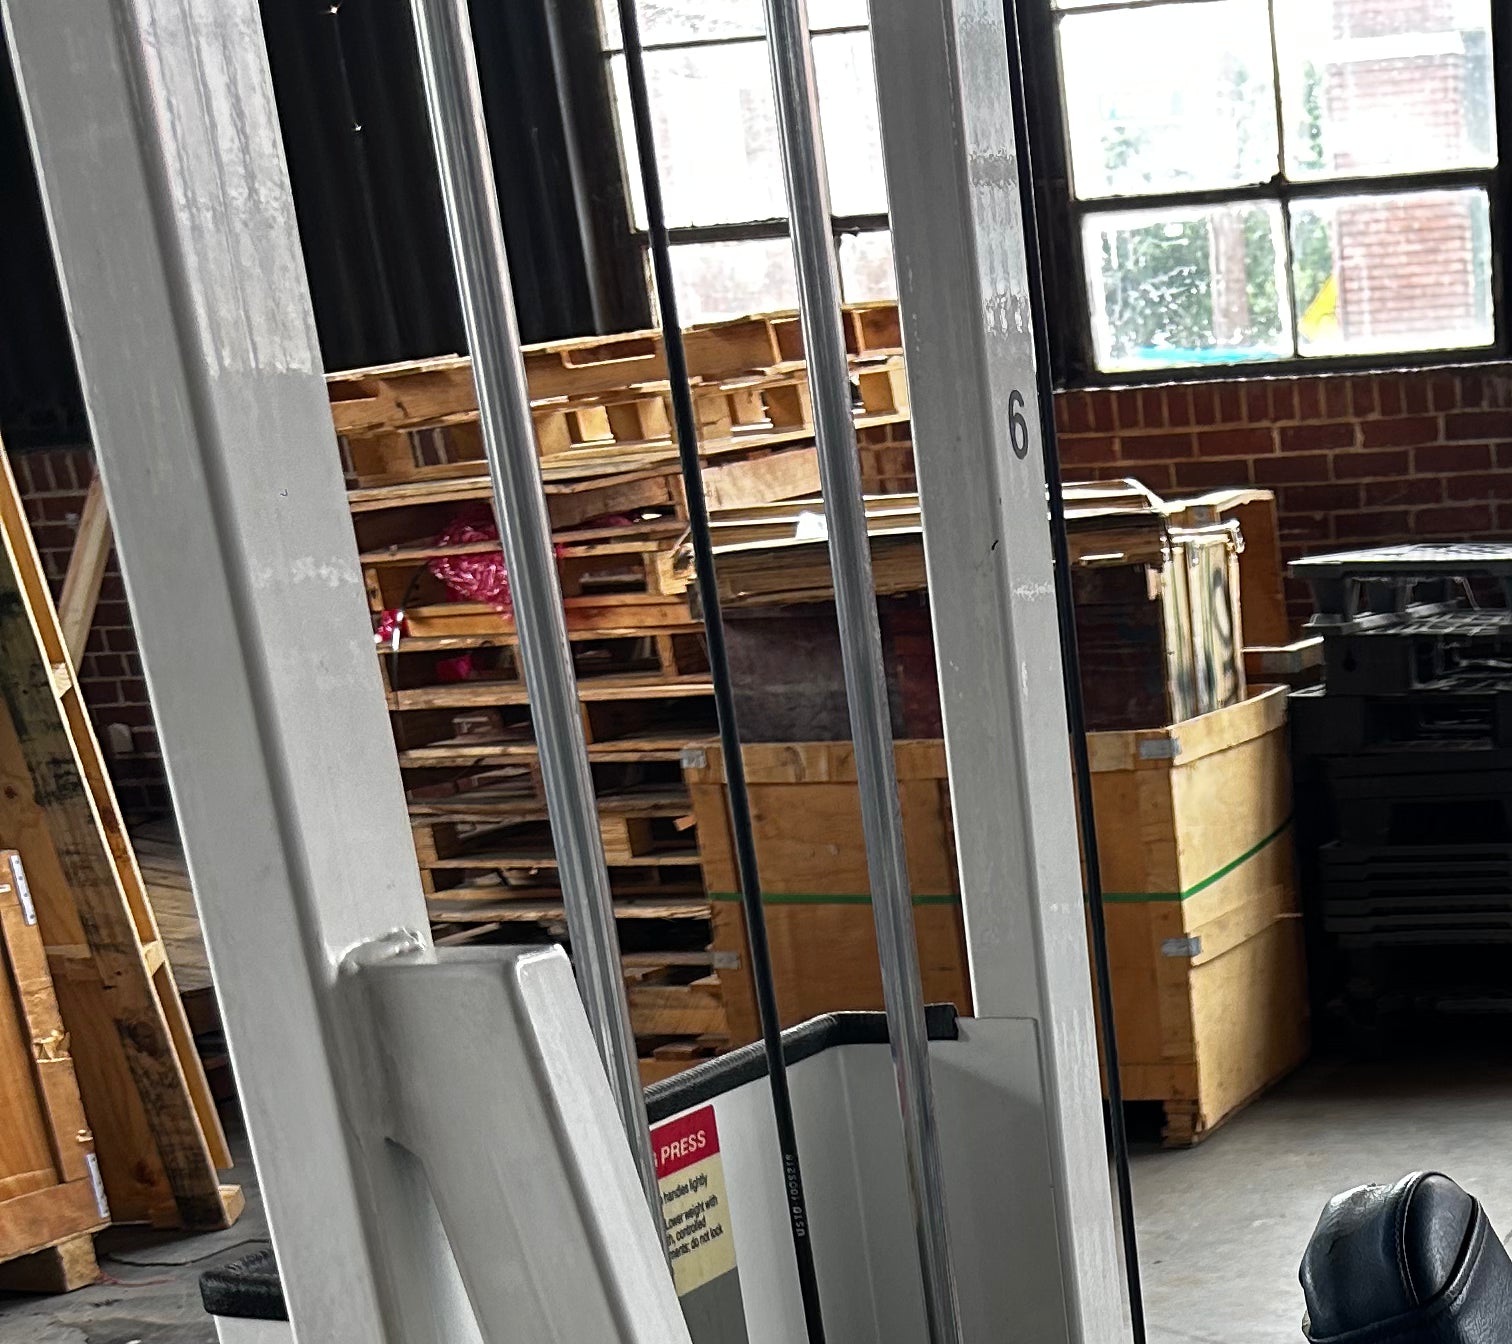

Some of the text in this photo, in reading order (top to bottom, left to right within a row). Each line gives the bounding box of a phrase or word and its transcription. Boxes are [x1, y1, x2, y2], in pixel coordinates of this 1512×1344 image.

[1009, 390, 1028, 460] 6
[661, 1130, 707, 1166] PRESS
[663, 1173, 707, 1204] handles lightly
[685, 1201, 705, 1219] weight
[705, 1194, 718, 1210] with
[676, 1214, 706, 1241] controlled
[691, 1236, 699, 1250] do
[700, 1230, 710, 1244] not
[710, 1223, 723, 1239] lock
